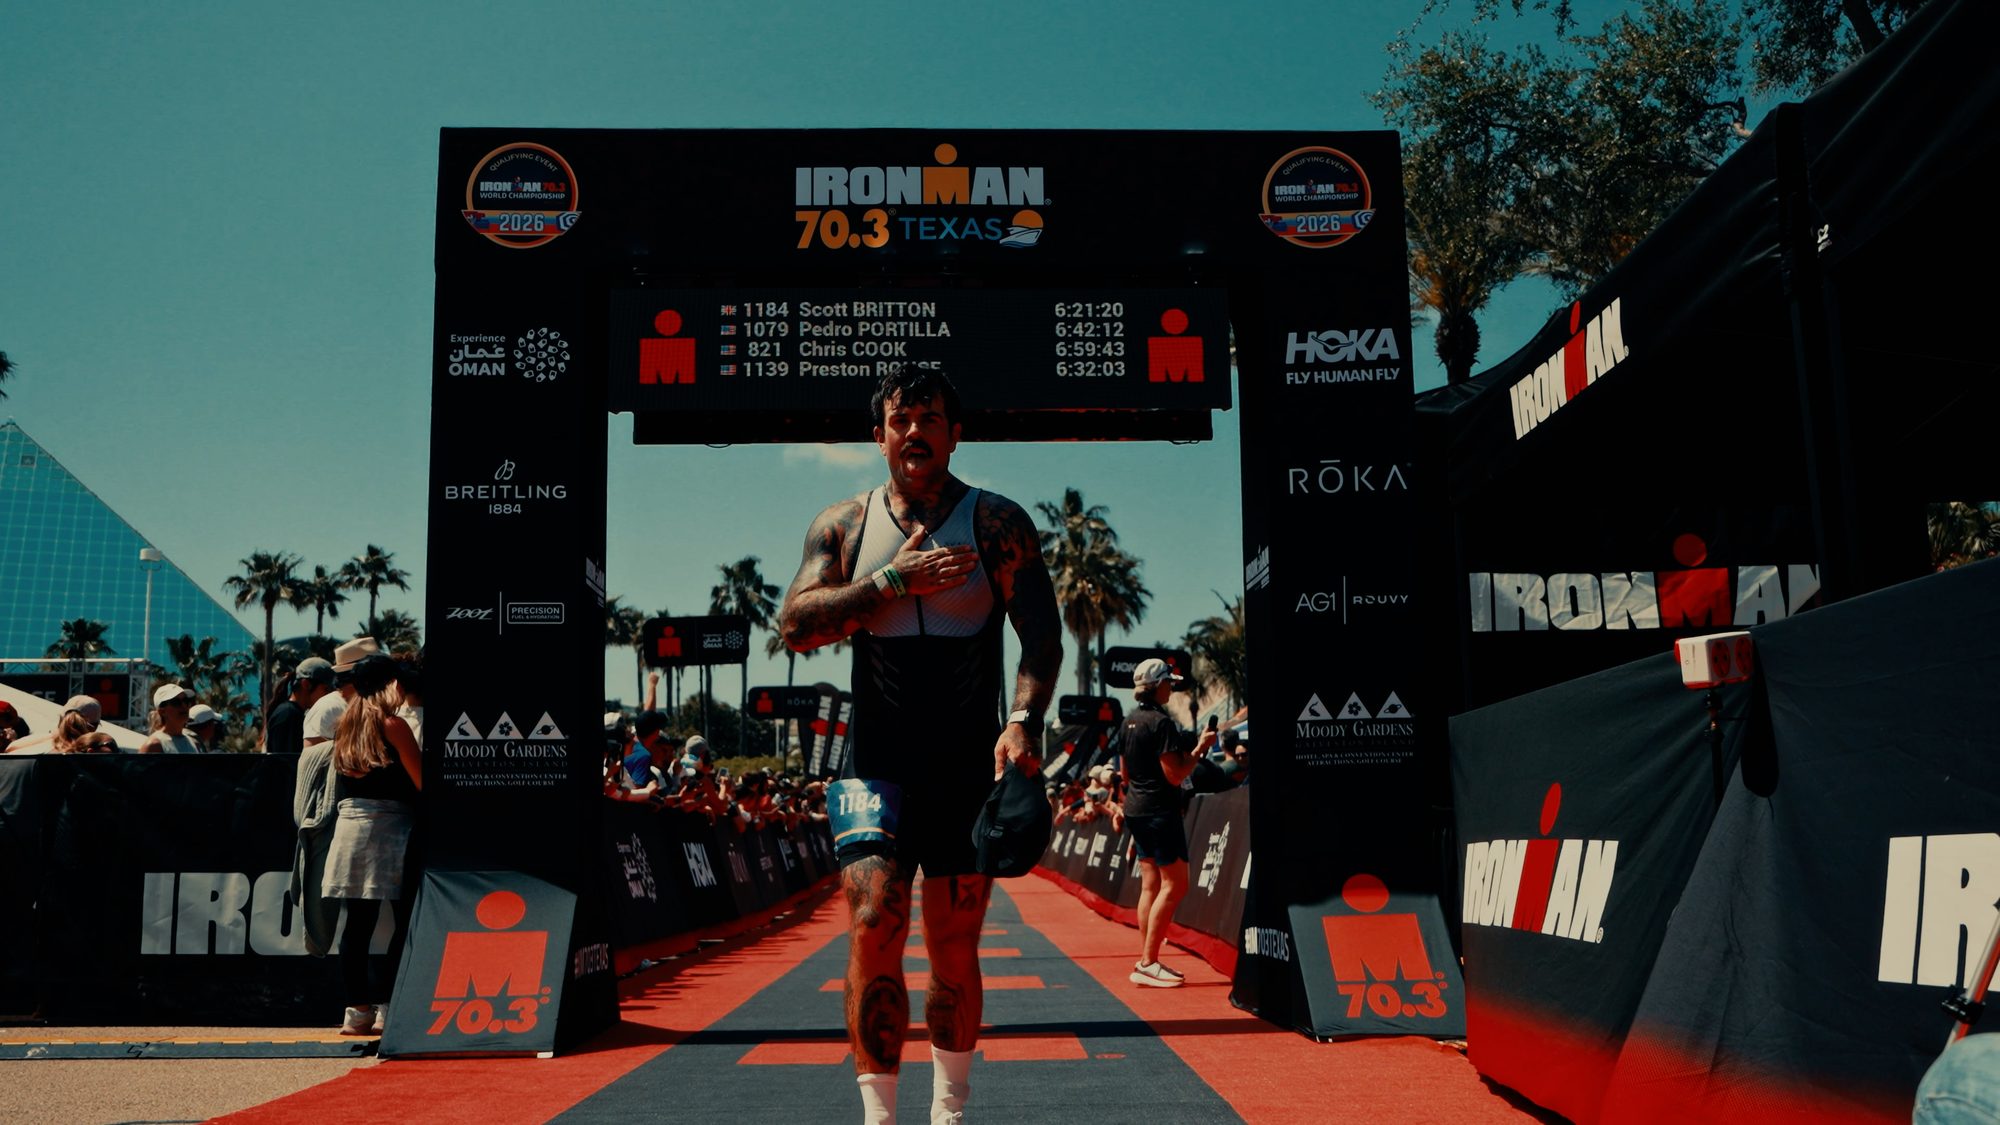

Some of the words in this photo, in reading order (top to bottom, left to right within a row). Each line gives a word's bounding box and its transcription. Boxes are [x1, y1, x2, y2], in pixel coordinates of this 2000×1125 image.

[489, 152, 534, 172] QUALIFYING
[535, 154, 559, 173] EVENT
[1282, 156, 1325, 176] QUALIFYING
[1325, 157, 1349, 174] EVENT
[795, 143, 1045, 206] IRONMAN
[480, 191, 507, 200] WORLD
[508, 191, 566, 200] CHAMPIONSHIP
[1275, 195, 1302, 203] WORLD
[1303, 192, 1359, 202] CHAMPIONSHIP
[499, 213, 545, 232] 2026
[795, 208, 890, 250] 70.3
[898, 217, 1002, 240] TEXAS
[1296, 214, 1341, 233] 2026
[744, 301, 790, 317] 1184
[799, 301, 849, 318] Scott
[852, 301, 937, 318] BRITTON
[1054, 302, 1124, 318] 6:21:20
[744, 321, 790, 337] 1079
[799, 321, 853, 337] Pedro
[857, 321, 951, 337] PORTILLA
[1055, 321, 1125, 338] 6:42:12
[450, 333, 506, 345] Experience
[1286, 327, 1400, 364] HOKA
[748, 341, 782, 357] 821
[799, 341, 847, 357] Chris
[852, 341, 908, 357] COOK
[1055, 341, 1126, 357] 6:59:43
[448, 362, 506, 377] OMAN
[743, 361, 790, 377] 1139
[799, 361, 871, 377] Preston
[875, 361, 942, 377] ROSE
[1056, 361, 1126, 377] 6:32:03
[1286, 371, 1311, 385] FLY
[1313, 369, 1374, 383] HUMAN
[1375, 367, 1401, 381] FLY
[1509, 297, 1625, 441] IRONMAN
[445, 485, 568, 500] BREITLING
[488, 503, 522, 515] 1884
[1295, 592, 1336, 612] AG1
[1352, 595, 1409, 604] ROUVY
[511, 606, 561, 615] PRECISION
[1111, 662, 1136, 673] HOK
[839, 792, 881, 816] 1184
[1462, 782, 1620, 944] IRONMAN
[140, 871, 396, 955] IRO
[1337, 983, 1448, 1018] 70.3
[426, 997, 539, 1035] 70.3
